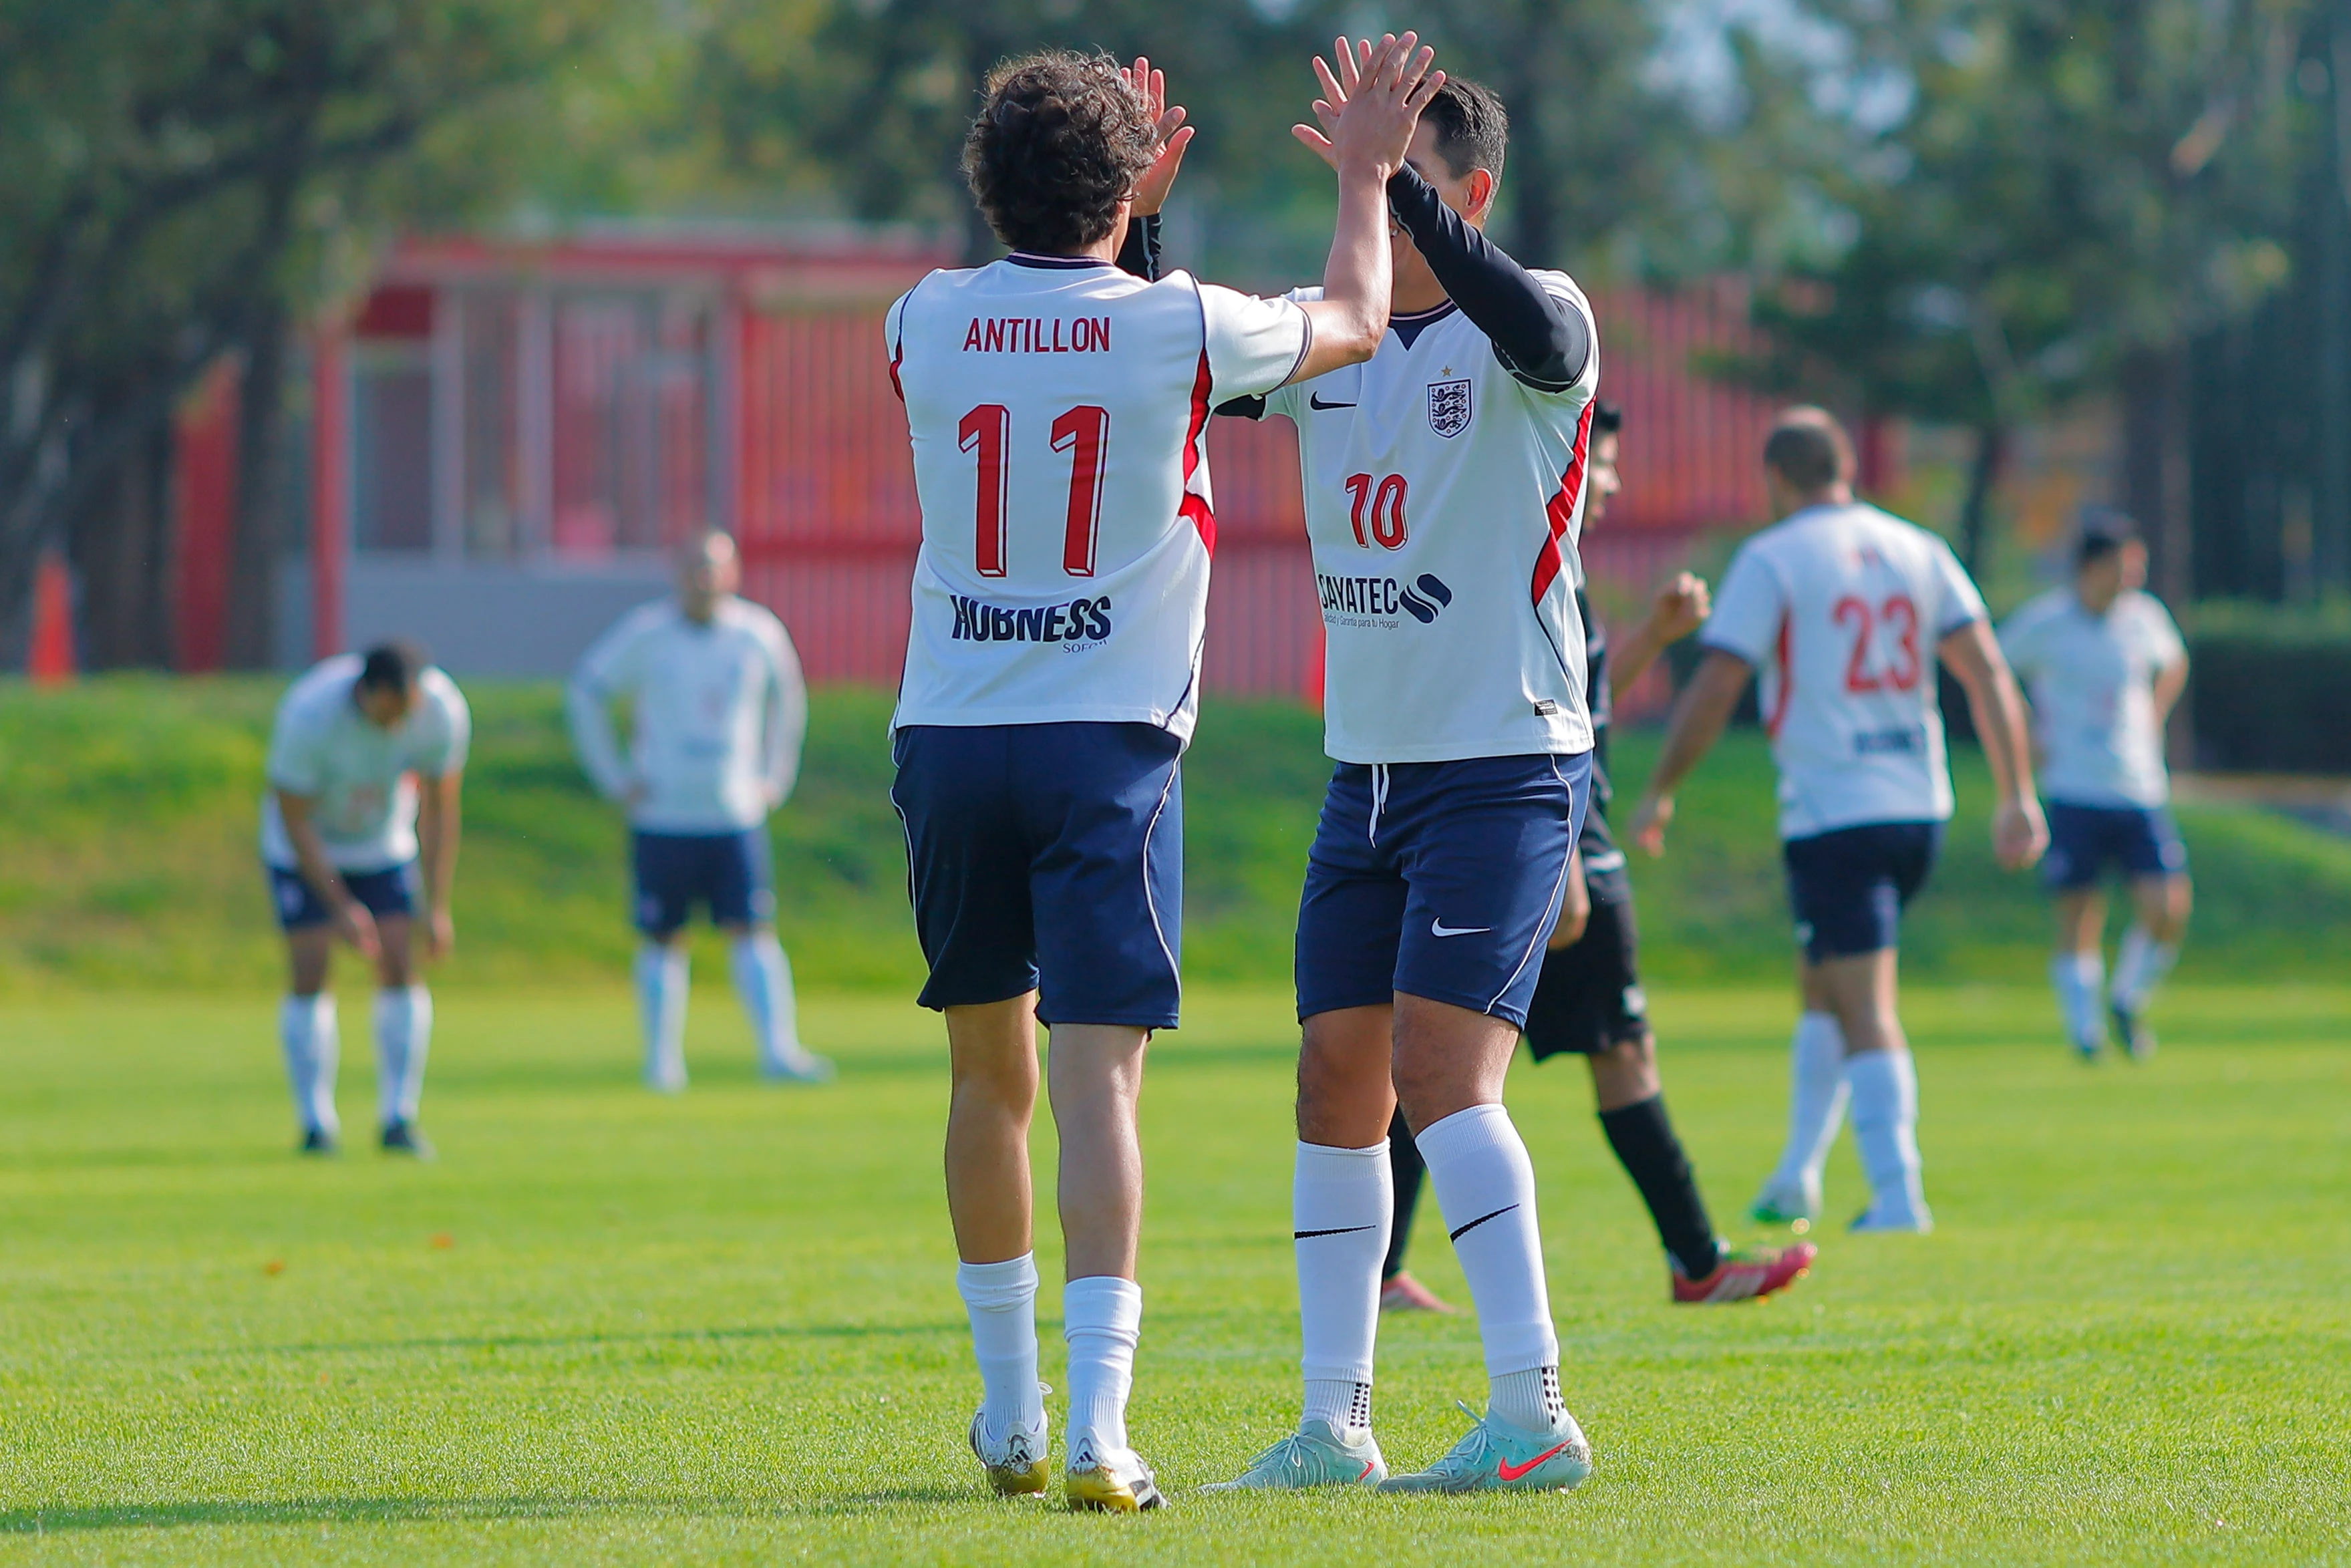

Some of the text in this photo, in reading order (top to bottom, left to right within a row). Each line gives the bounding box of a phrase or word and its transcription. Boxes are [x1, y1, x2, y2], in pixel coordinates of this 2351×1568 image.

[962, 316, 1110, 353] ANTILLON
[958, 404, 1110, 578] 11
[1345, 473, 1409, 551] 10
[1318, 574, 1399, 615] SAYATEC
[949, 595, 1112, 642] HUBNESS
[1358, 619, 1371, 628] para
[1372, 618, 1378, 627] tu
[1379, 618, 1399, 630] Hogar
[1832, 594, 1921, 693] 23
